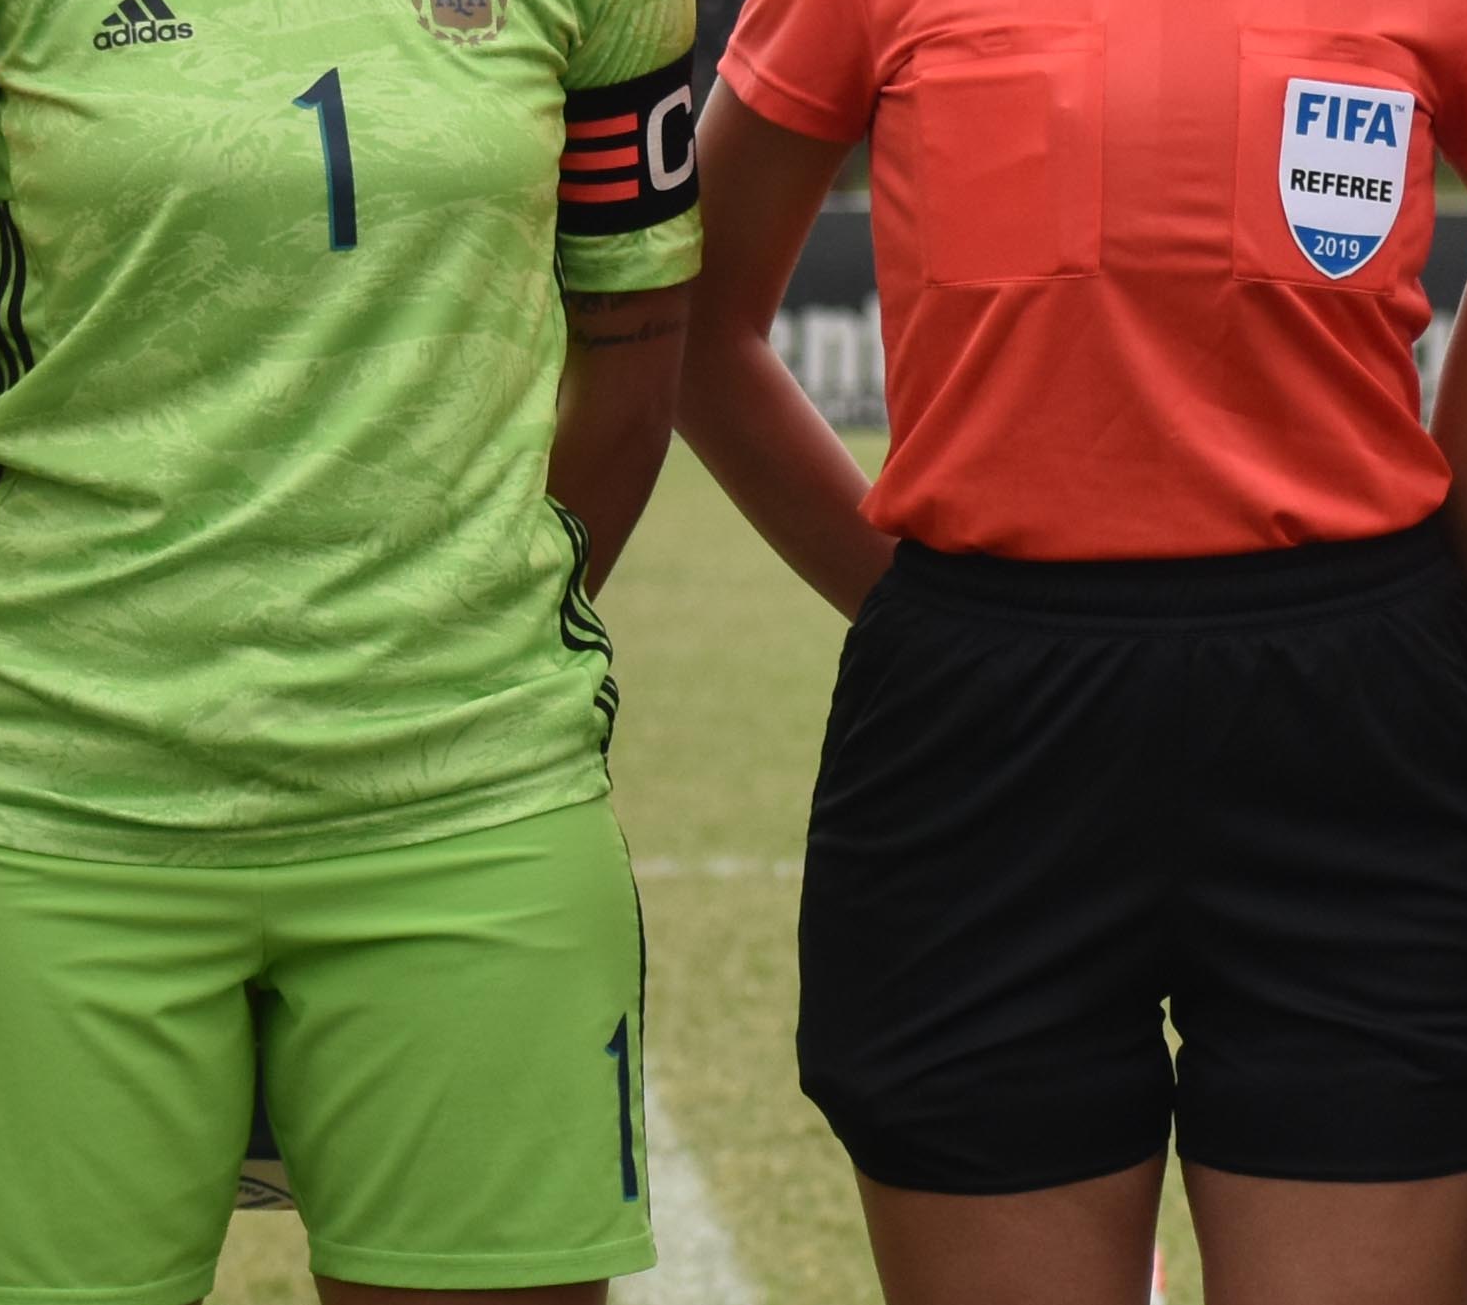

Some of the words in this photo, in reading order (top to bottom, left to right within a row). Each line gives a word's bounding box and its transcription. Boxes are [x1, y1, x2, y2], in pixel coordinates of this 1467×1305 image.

[93, 19, 194, 51] adidas
[646, 84, 695, 192] C
[1296, 92, 1397, 147] FIFA
[292, 67, 357, 251] 1
[1290, 168, 1393, 203] REFEREE
[1313, 235, 1360, 260] 2019
[604, 1011, 639, 1203] 1
